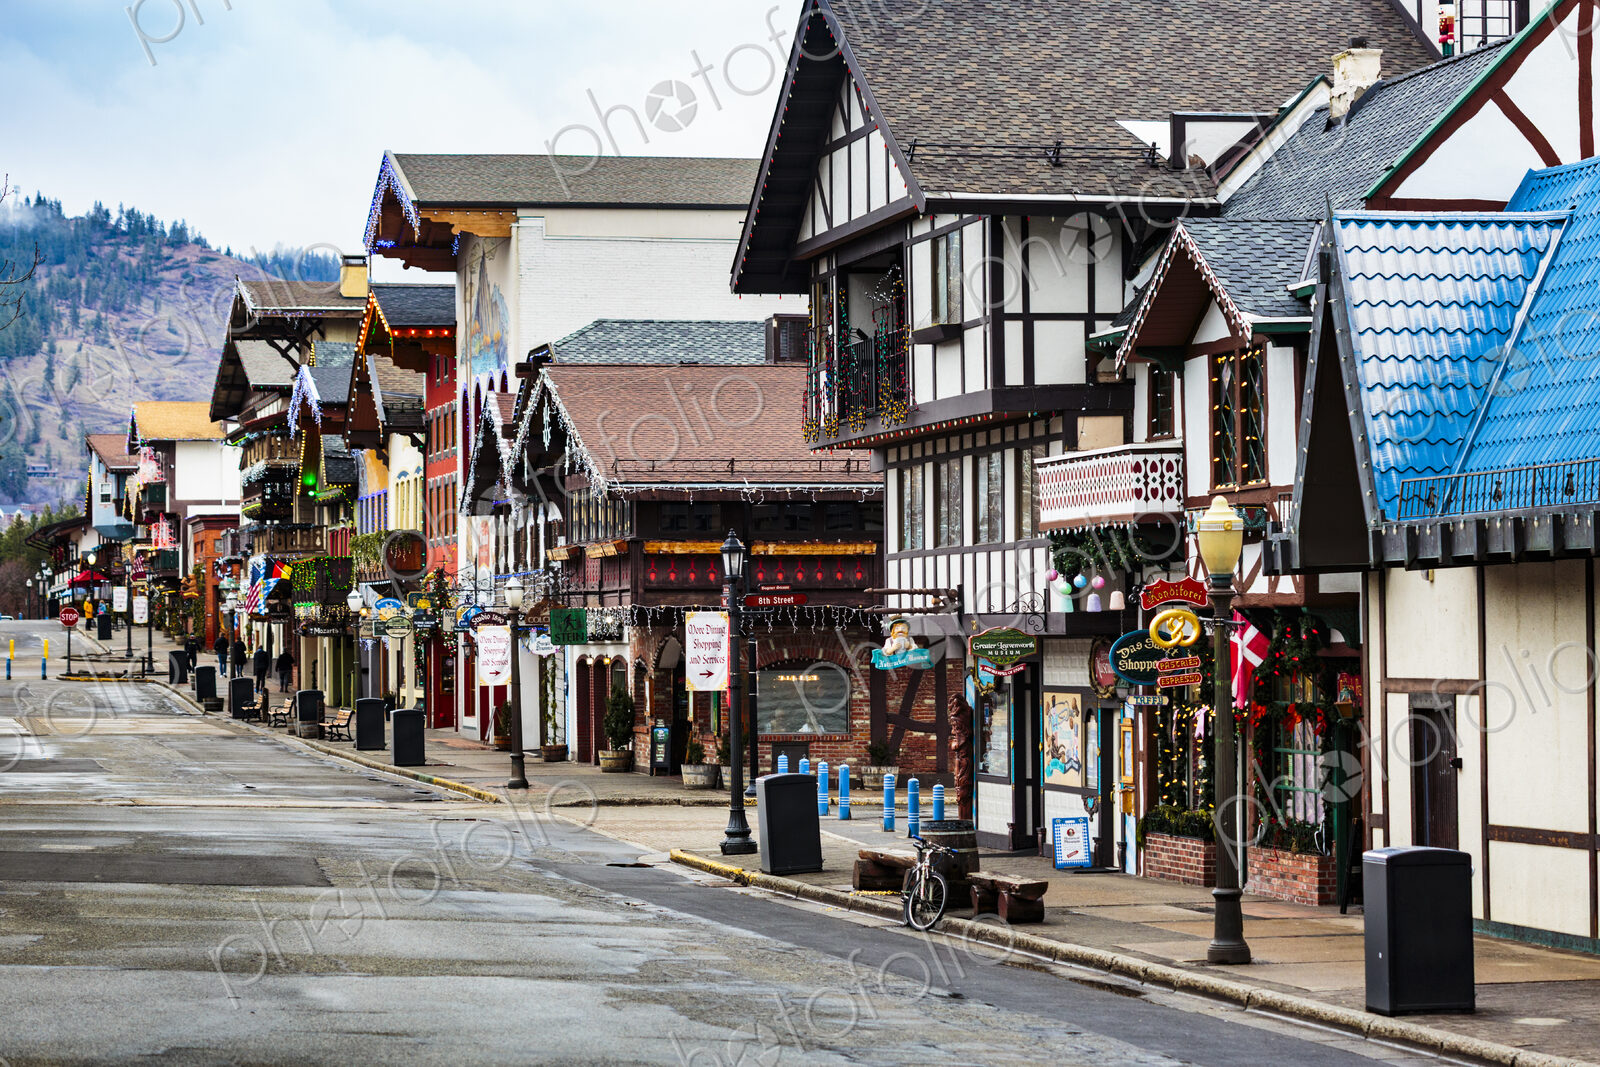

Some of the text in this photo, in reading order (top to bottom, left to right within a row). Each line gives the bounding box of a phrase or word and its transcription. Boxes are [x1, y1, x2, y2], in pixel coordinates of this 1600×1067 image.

[758, 597, 794, 605] 8th Street
[61, 613, 78, 621] STOP
[471, 613, 491, 625] Studio
[705, 624, 726, 636] Dining
[554, 632, 585, 642] STEIN
[693, 639, 722, 651] Shopping
[973, 641, 1034, 650] Greater Leavenworth
[1116, 641, 1143, 659] Das
[483, 646, 507, 657] Shopping
[689, 654, 725, 664] and Services
[1161, 675, 1200, 686] ESPRESSO
